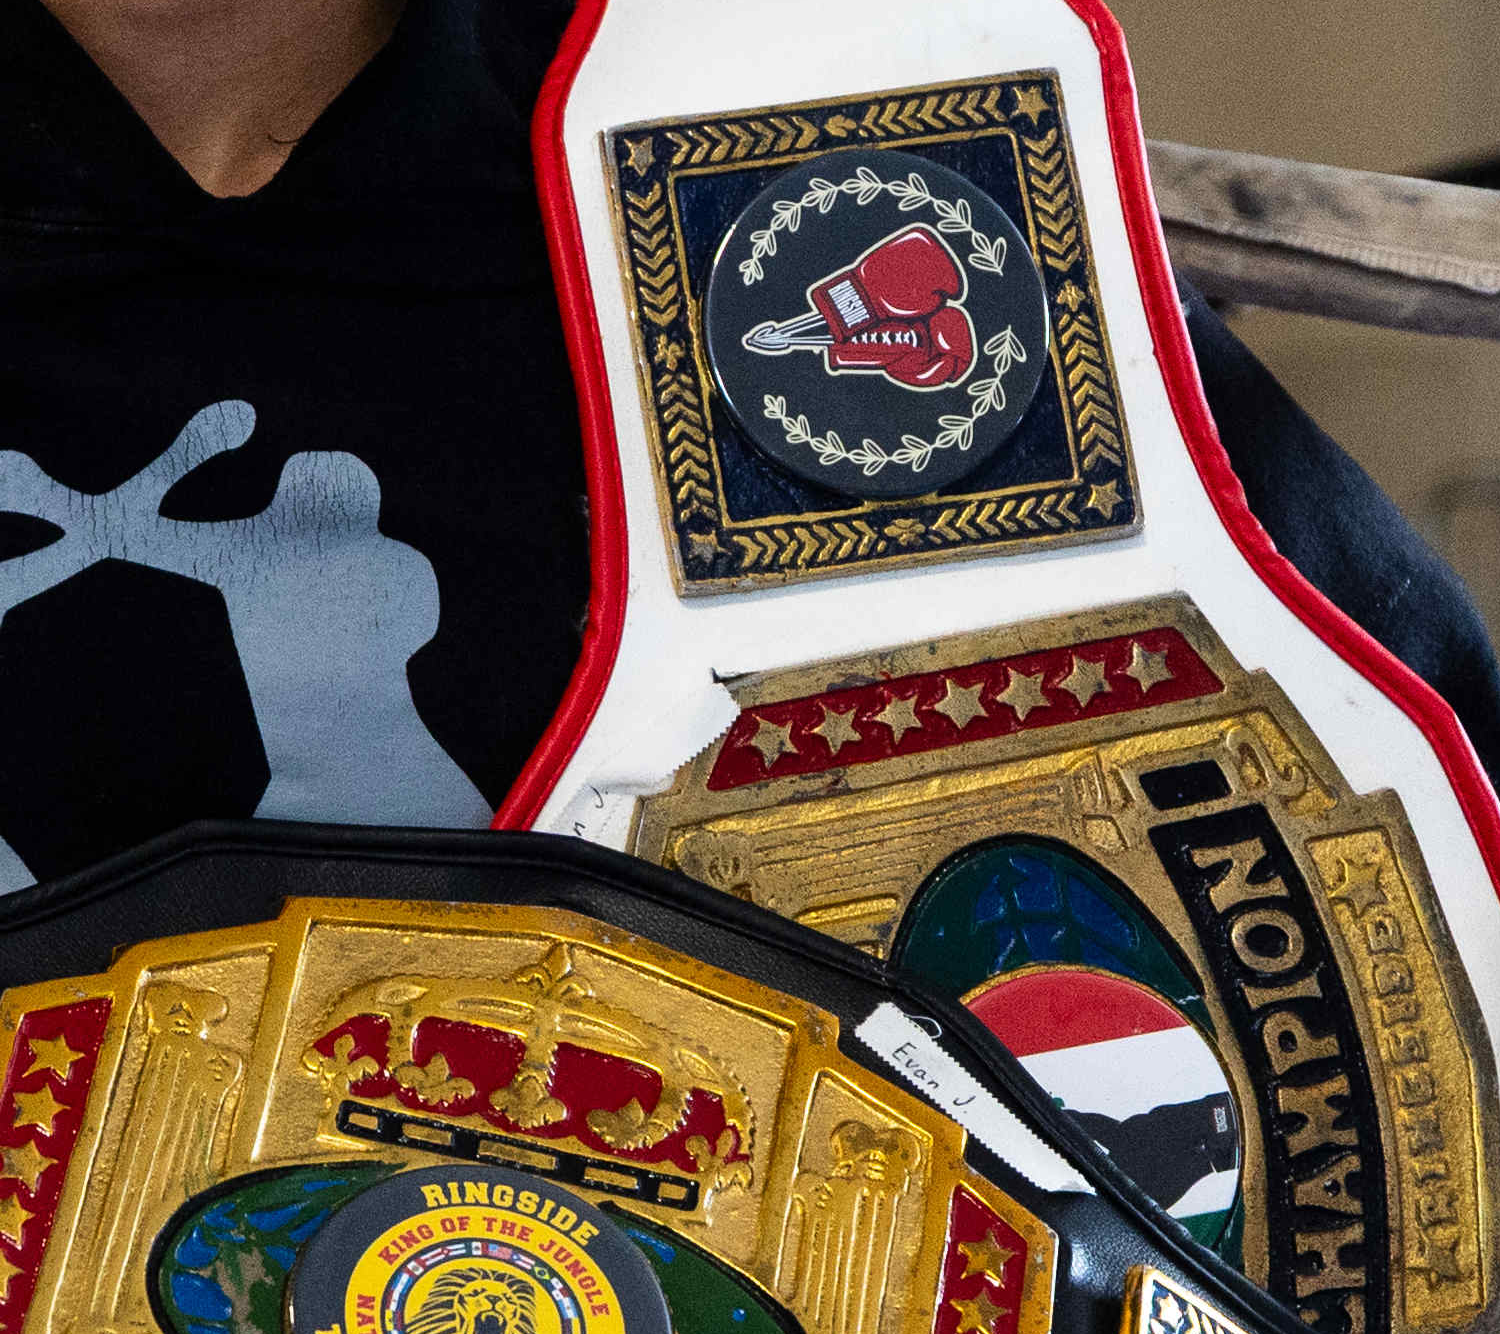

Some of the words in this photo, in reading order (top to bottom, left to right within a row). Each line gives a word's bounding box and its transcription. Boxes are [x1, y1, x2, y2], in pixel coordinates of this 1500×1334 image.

[892, 1042, 940, 1090] Evan
[420, 1180, 601, 1247] RINGSIDE
[377, 1223, 435, 1268] KING
[441, 1216, 472, 1235] OF
[482, 1216, 536, 1243] THE
[538, 1238, 611, 1318] JUNGLE
